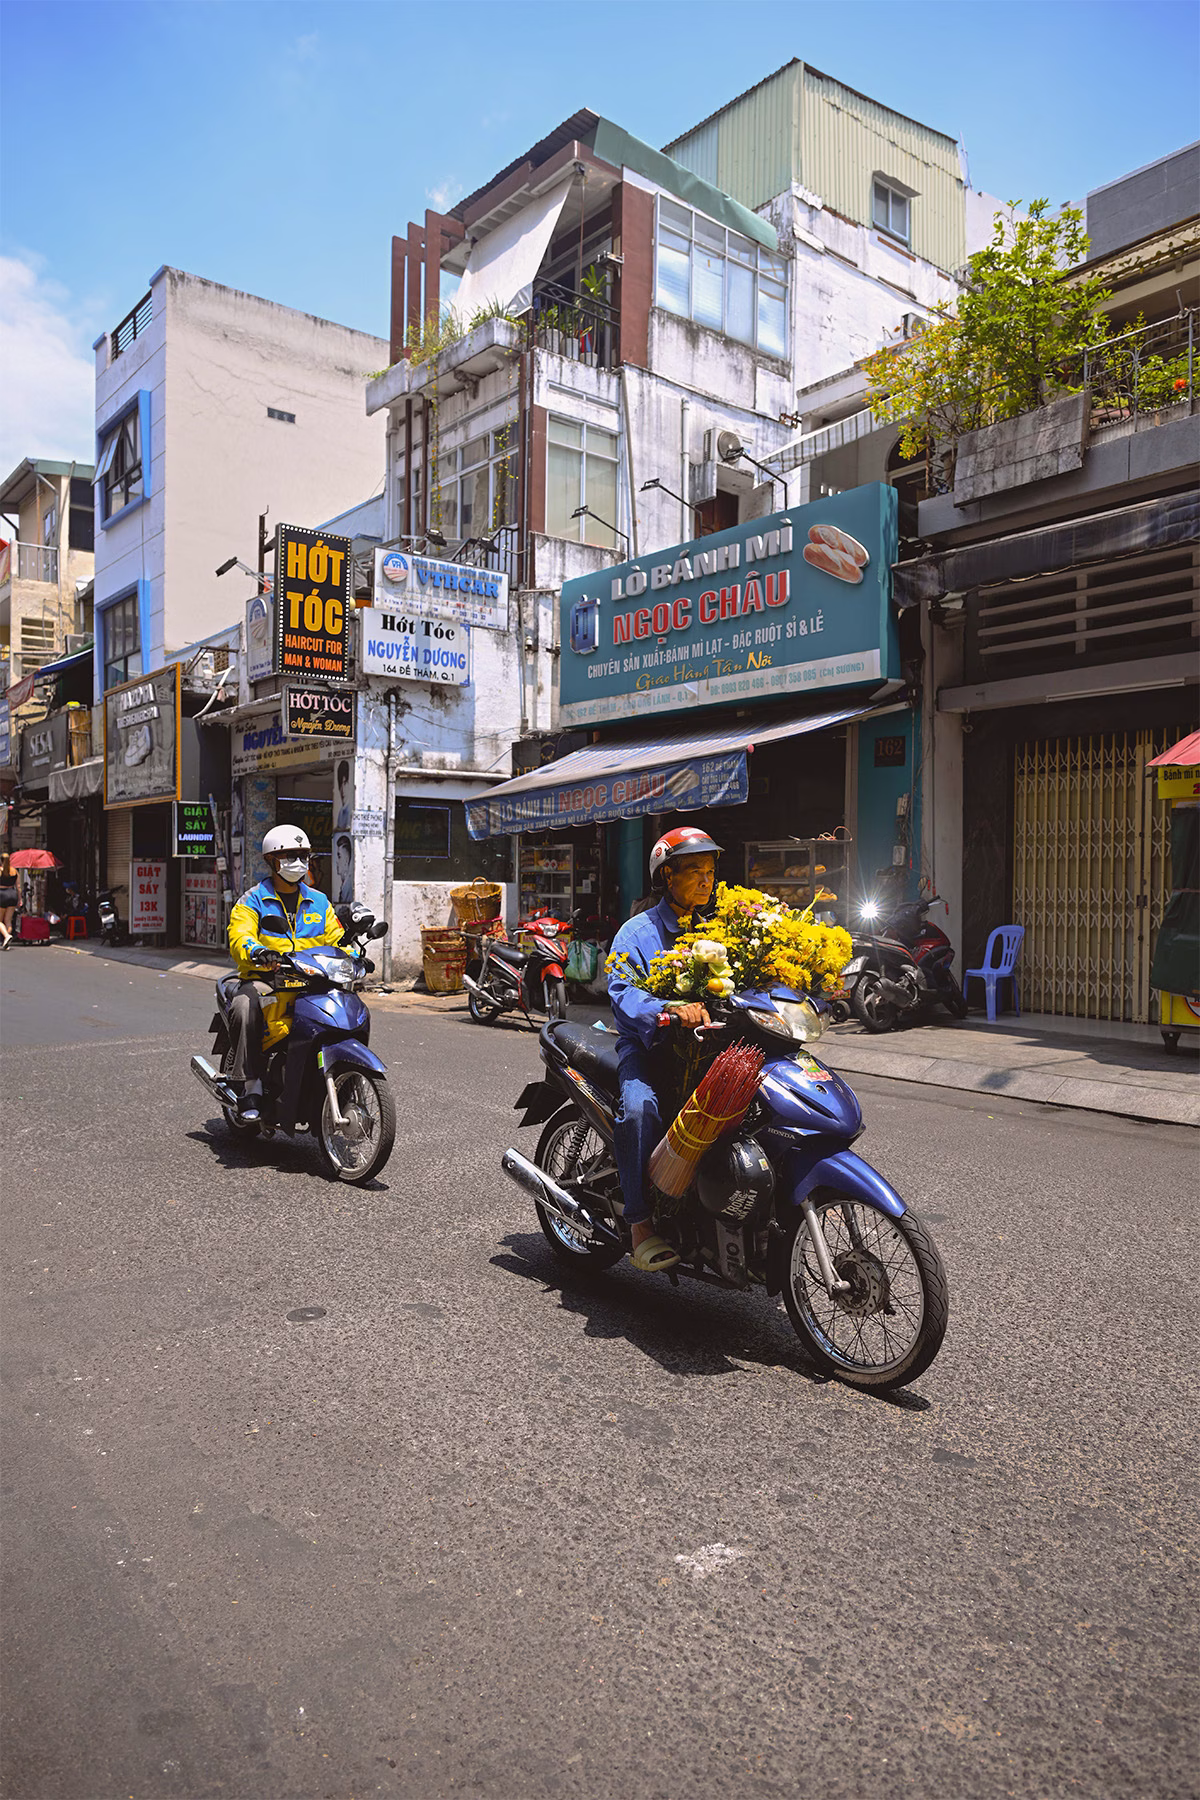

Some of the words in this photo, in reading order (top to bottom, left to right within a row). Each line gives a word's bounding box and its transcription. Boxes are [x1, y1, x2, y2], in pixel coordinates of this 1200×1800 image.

[287, 540, 345, 587] HỚT
[611, 565, 647, 600] LÒ
[651, 549, 740, 590] BÁNH
[746, 518, 792, 562] MÌ
[417, 568, 499, 599] VTHCAR
[286, 588, 344, 635] TÓC
[613, 598, 692, 645] NGỌC
[699, 569, 791, 624] CHÂU
[381, 614, 416, 634] Hớt
[421, 620, 456, 641] Tóc
[284, 633, 324, 653] HAIRCUT
[326, 640, 342, 655] FOR
[368, 636, 419, 662] NGUYỄN
[423, 648, 467, 670] DƯƠNG
[587, 658, 620, 679] CHUYÊN
[623, 652, 640, 673] SẢN
[692, 639, 704, 659] MÌ
[706, 638, 723, 658] LẠT
[732, 629, 752, 653] ĐẶC
[754, 622, 782, 647] RUỘT
[800, 620, 808, 636] &
[810, 609, 824, 634] LẺ
[284, 653, 302, 667] MAN
[304, 655, 312, 668] &
[312, 656, 343, 672] WOMAN
[383, 664, 396, 674] 164
[636, 674, 670, 691] Giao
[674, 663, 710, 691] Hàng
[290, 690, 320, 710] HỚT
[322, 694, 352, 713] TÓC
[29, 730, 53, 758] SESA
[879, 738, 903, 756] 162
[515, 797, 540, 819] BÁNH
[558, 784, 607, 814] NGỌC
[612, 772, 666, 804] CHÂU
[186, 845, 207, 854] 13K
[140, 901, 158, 912] 13K
[302, 910, 322, 924] be
[767, 1127, 796, 1140] HONDA
